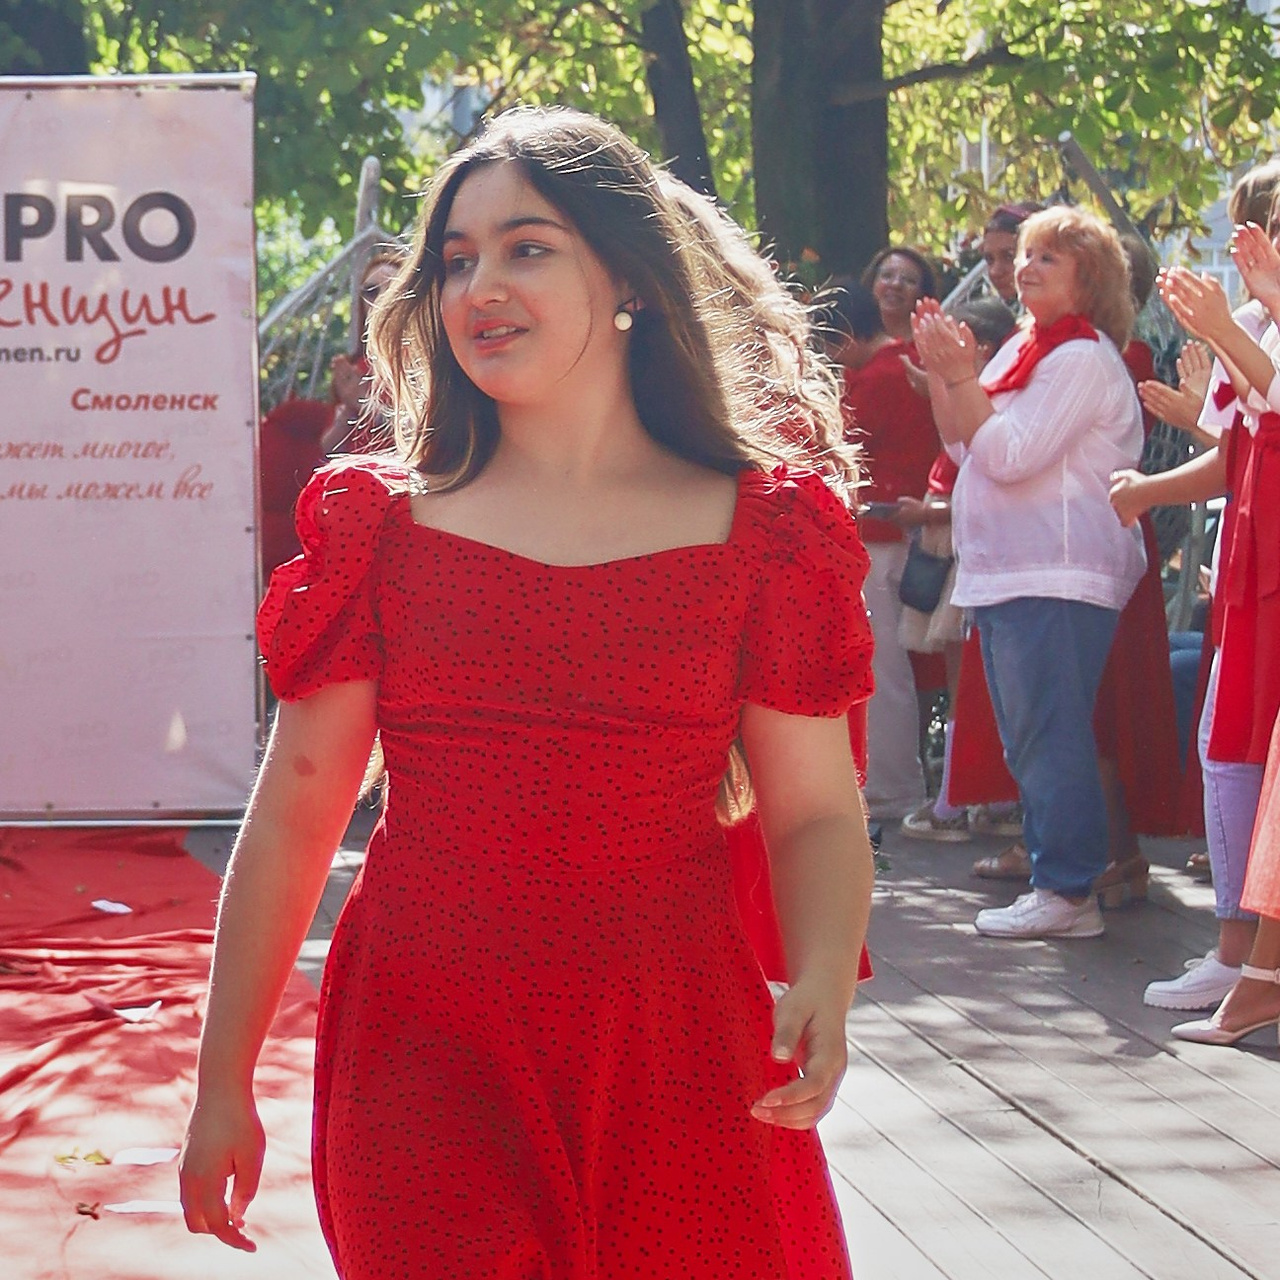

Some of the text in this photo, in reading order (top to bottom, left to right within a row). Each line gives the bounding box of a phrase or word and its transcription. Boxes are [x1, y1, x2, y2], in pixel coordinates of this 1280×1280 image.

[3, 190, 197, 264] PRO
[71, 387, 219, 412] Смоленск
[0, 483, 48, 500] мы
[56, 482, 165, 500] можем
